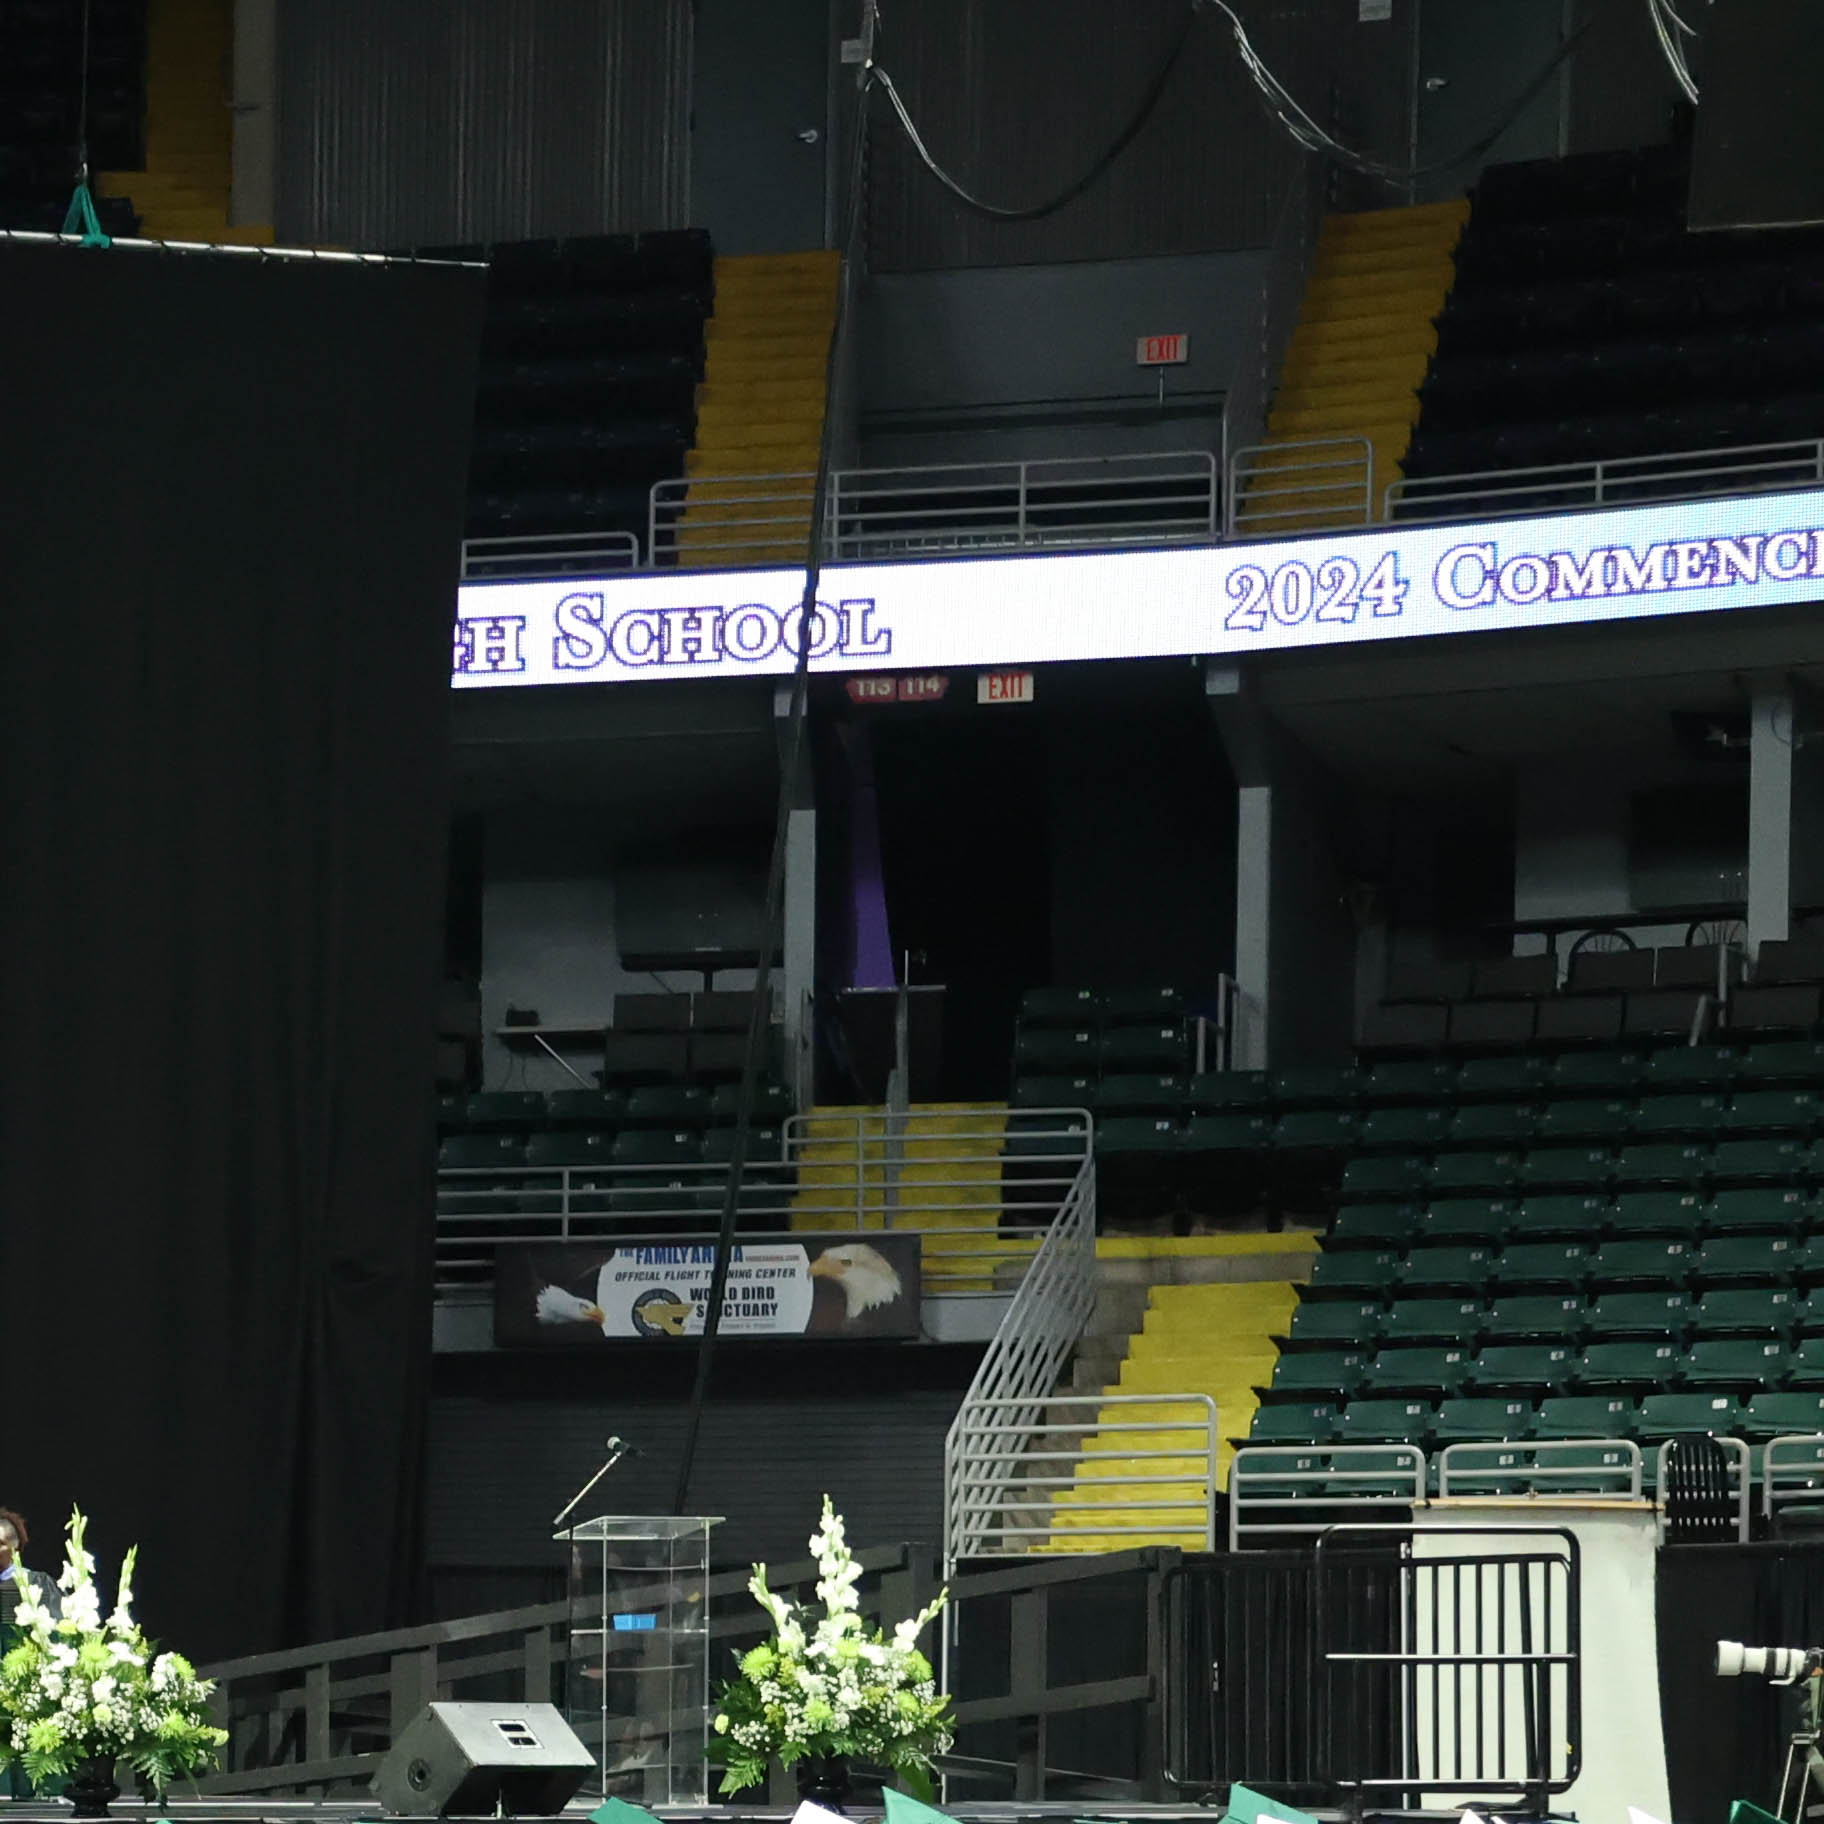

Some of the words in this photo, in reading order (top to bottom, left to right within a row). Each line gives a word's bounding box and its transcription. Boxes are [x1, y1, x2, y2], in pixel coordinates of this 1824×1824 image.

[1225, 550, 1410, 632] 2024
[554, 590, 892, 671] SCHOOL
[906, 676, 939, 695] 114
[988, 672, 1027, 700] EXIT
[615, 1270, 661, 1282] OFFICIAL
[664, 1270, 701, 1281] FLIGHT
[703, 1268, 752, 1280] TNING
[755, 1268, 796, 1279] CENTER
[741, 1286, 776, 1301] BIRD
[695, 1302, 779, 1319] SCTUARY
